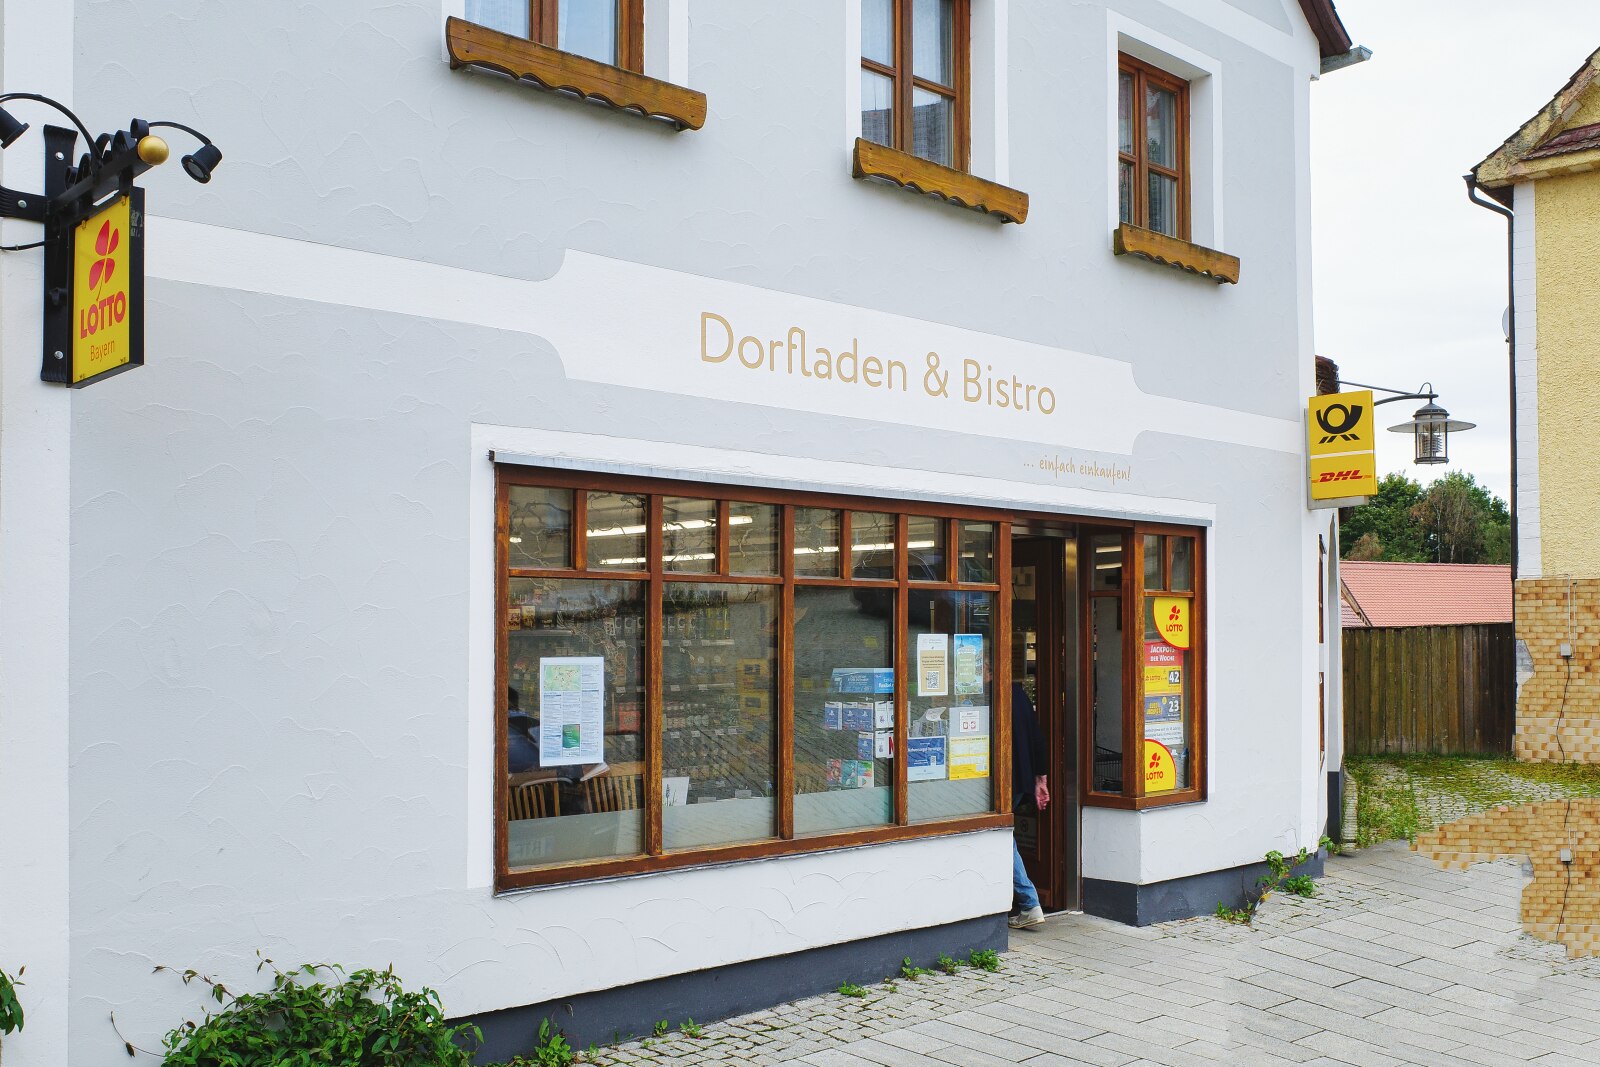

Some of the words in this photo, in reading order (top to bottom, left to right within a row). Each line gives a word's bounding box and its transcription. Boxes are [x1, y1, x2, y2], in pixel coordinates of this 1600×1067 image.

[80, 291, 126, 339] LOTTO
[90, 341, 115, 362] Bayern
[700, 312, 907, 391] Dorfladen
[924, 352, 949, 398] &
[963, 358, 1056, 415] Bistro
[1039, 454, 1076, 479] einfach
[1080, 460, 1131, 485] einkaufen!
[1320, 470, 1363, 482] DHL
[1166, 624, 1183, 632] LOTTO
[1169, 671, 1180, 683] 42
[1168, 700, 1179, 712] 23
[1146, 771, 1163, 780] LOTTO
